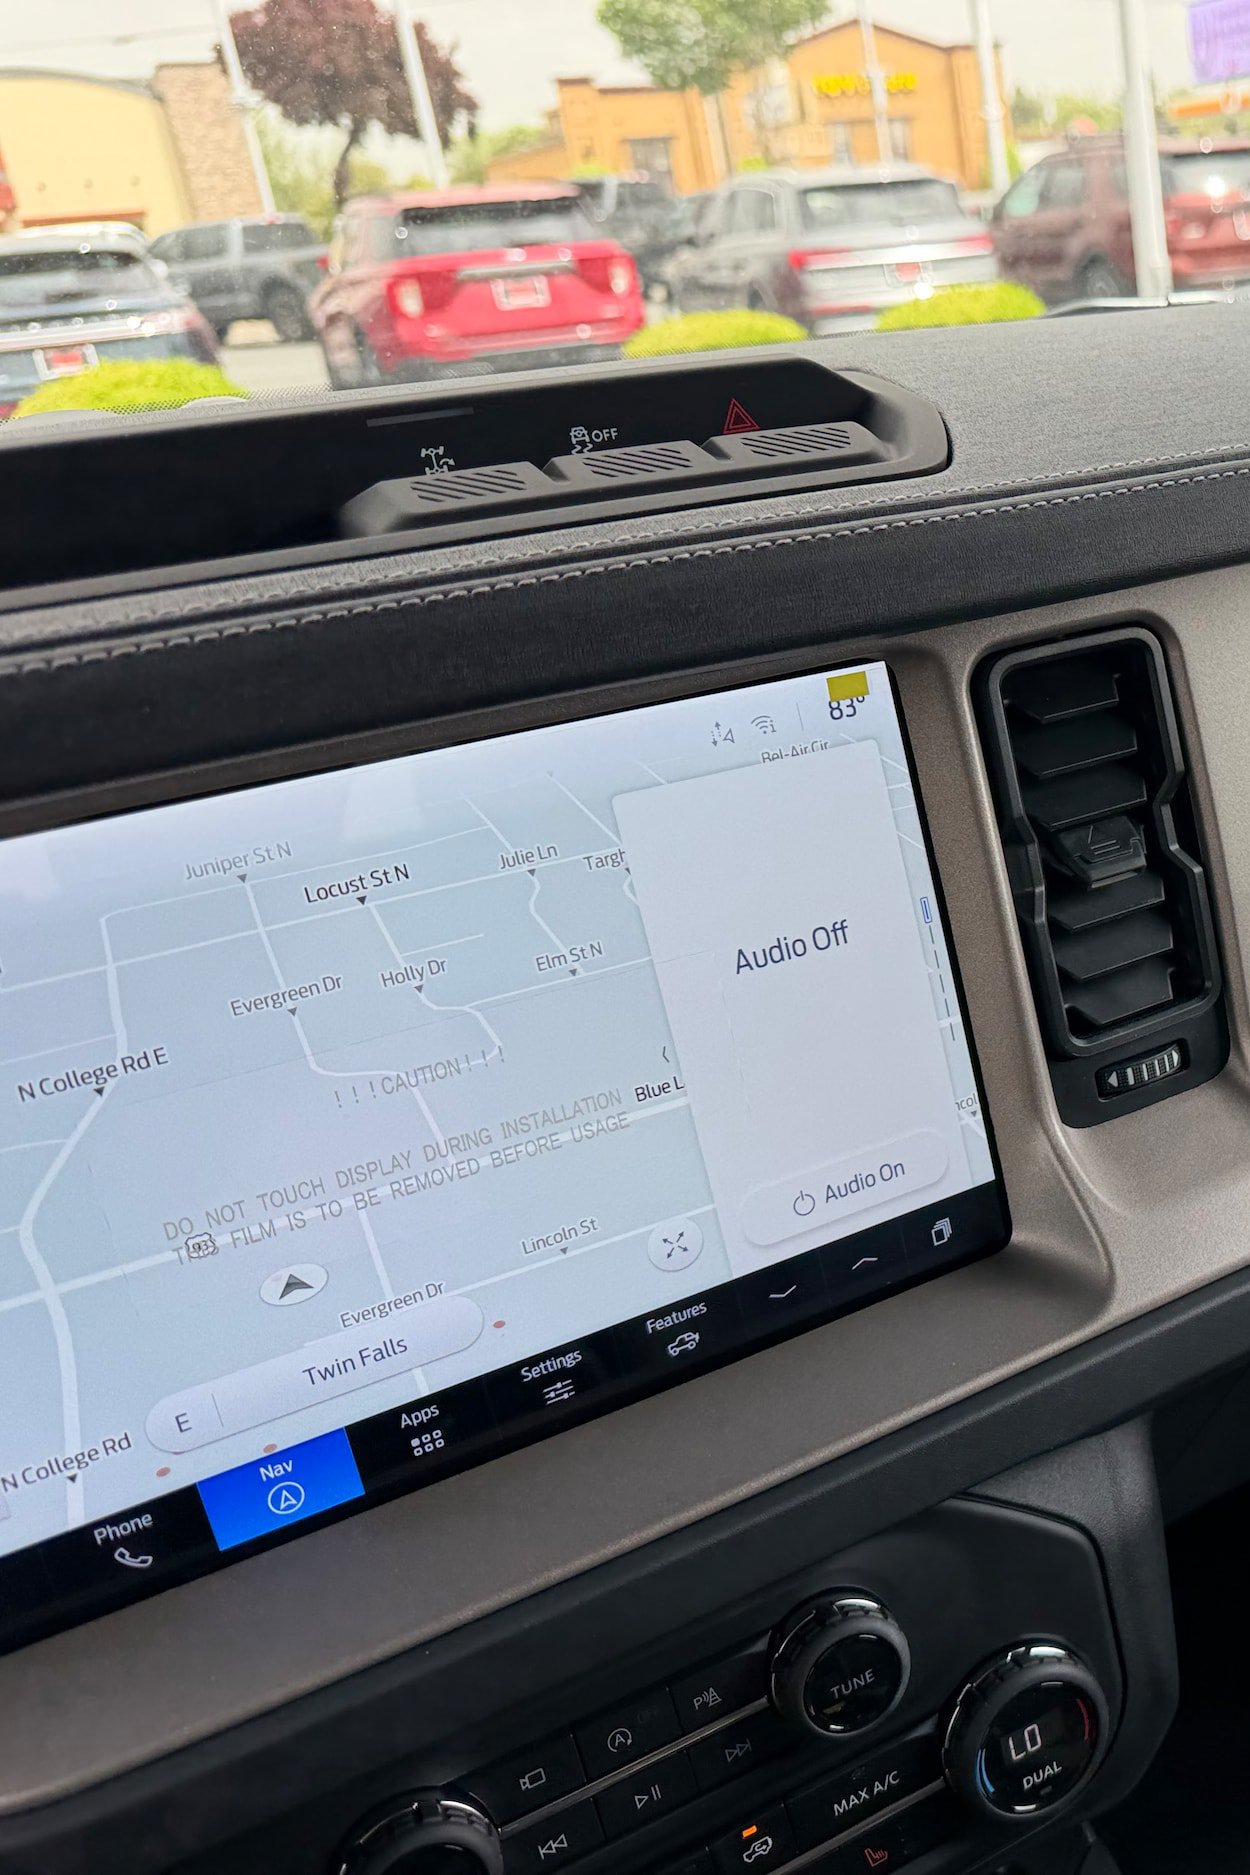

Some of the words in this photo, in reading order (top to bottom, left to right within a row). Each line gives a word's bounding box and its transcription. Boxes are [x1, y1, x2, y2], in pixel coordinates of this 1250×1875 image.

[591, 427, 619, 443] OFF
[185, 853, 249, 880] Juniper
[252, 846, 274, 864] St
[277, 841, 292, 859] N
[500, 850, 535, 870] Julie
[536, 845, 558, 860] Ln
[303, 874, 368, 903] Locust
[370, 868, 392, 888] St
[394, 863, 410, 882] N
[536, 954, 568, 971] Elm
[569, 946, 588, 962] St
[589, 941, 603, 957] N
[735, 936, 807, 974] Audio
[811, 919, 850, 952] Off
[381, 965, 425, 988] Holly
[428, 959, 447, 976] Dr
[230, 981, 320, 1016] Evergreen
[321, 975, 343, 992] Dr
[17, 1082, 36, 1102] N
[39, 1063, 118, 1096] College
[121, 1050, 151, 1074] Rd
[153, 1046, 169, 1065] E
[634, 1081, 672, 1103] Blue
[162, 1216, 194, 1241] DO
[205, 1200, 246, 1229] NOT
[256, 1176, 326, 1212] TOUCH
[335, 1150, 413, 1189] DISPLAY
[423, 1126, 493, 1163] DURING
[500, 1087, 623, 1140] INSTALLATION
[230, 1218, 278, 1249] FILM
[285, 1210, 307, 1232] IS
[315, 1199, 343, 1223] TO
[352, 1188, 382, 1211] BE
[390, 1157, 481, 1200] REMOVED
[490, 1132, 563, 1168] BEFORE
[571, 1111, 631, 1143] USAGE
[825, 1172, 877, 1203] Audio
[879, 1160, 907, 1183] On
[521, 1225, 579, 1256] Lincoln
[578, 1217, 599, 1236] St
[340, 1289, 424, 1328] Evergreen
[425, 1281, 445, 1298] Dr
[646, 1300, 708, 1334] Features
[174, 1411, 193, 1434] E
[302, 1357, 356, 1386] Twin
[358, 1337, 408, 1367] Falls
[520, 1349, 583, 1383] Settings
[399, 1404, 440, 1430] Apps
[1, 1473, 19, 1493] N
[21, 1448, 100, 1485] College
[101, 1431, 133, 1457] Rd
[258, 1459, 295, 1483] Nav
[93, 1512, 154, 1546] Phone
[829, 1668, 876, 1700] TUNE
[832, 1788, 871, 1818] MAX
[873, 1769, 901, 1796] A/C
[1022, 1760, 1063, 1791] DUAL
